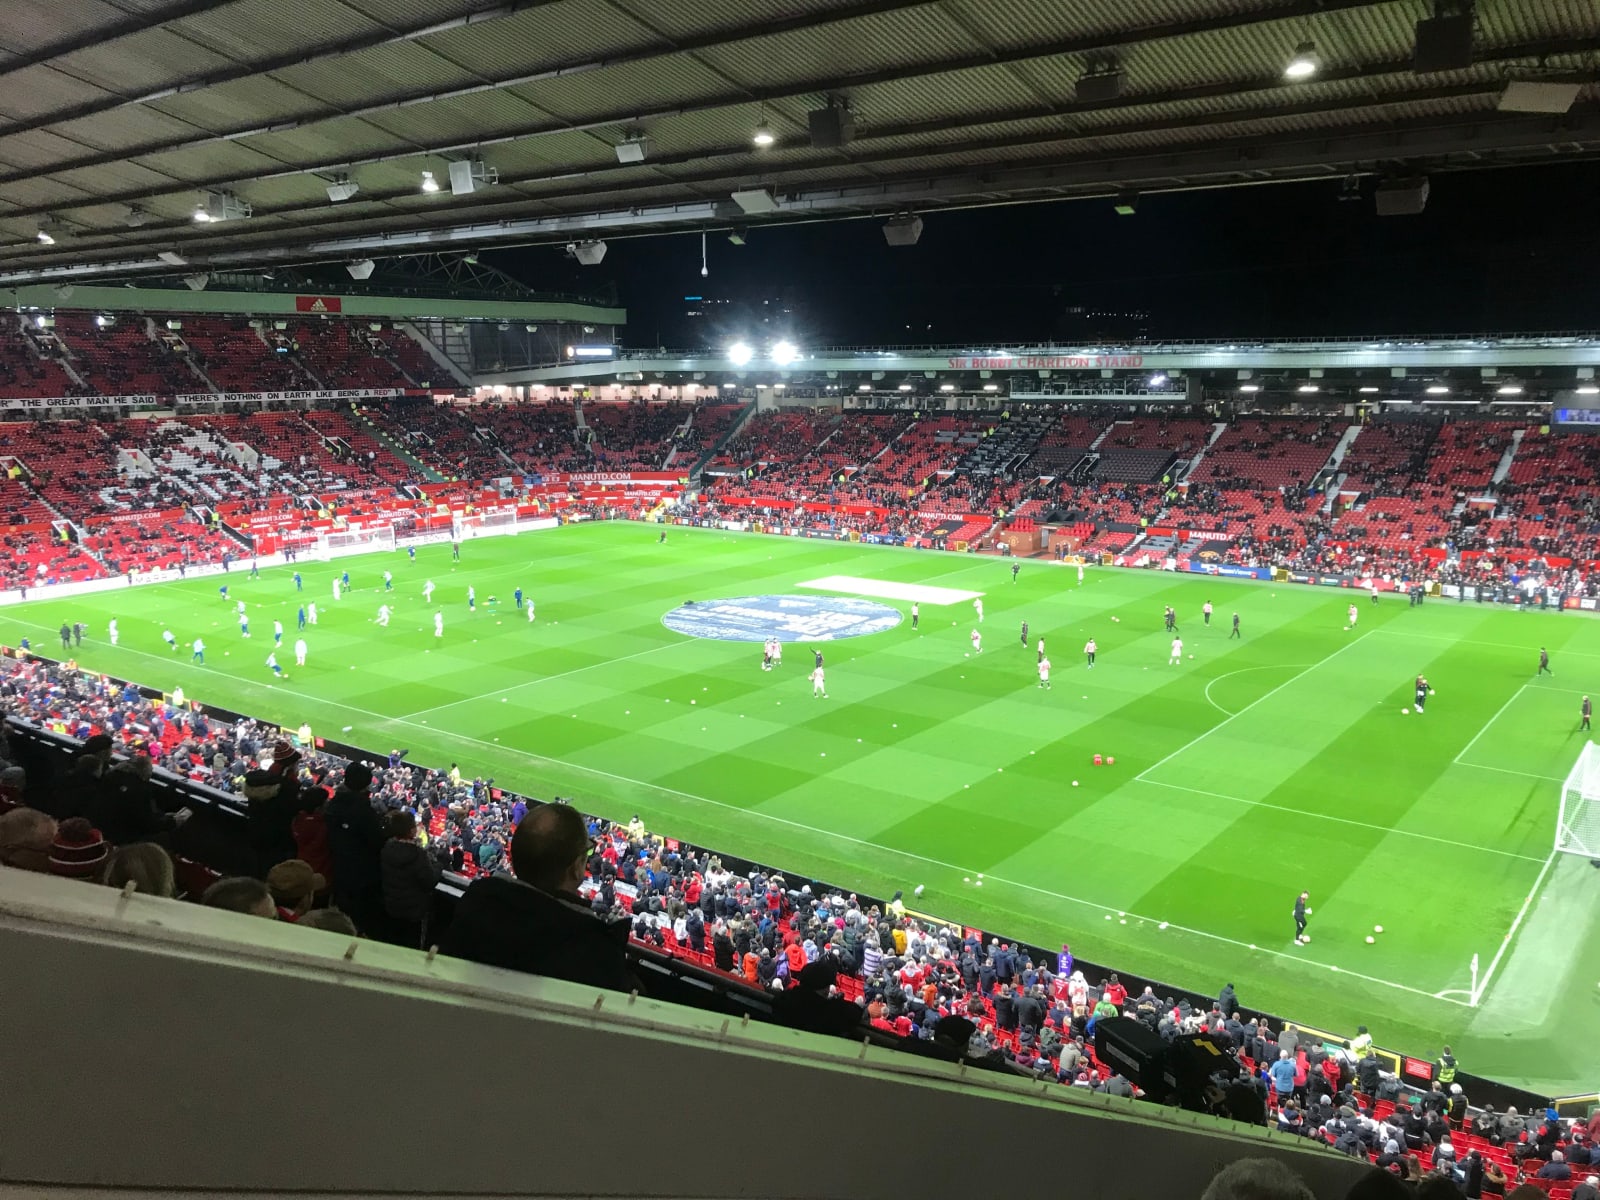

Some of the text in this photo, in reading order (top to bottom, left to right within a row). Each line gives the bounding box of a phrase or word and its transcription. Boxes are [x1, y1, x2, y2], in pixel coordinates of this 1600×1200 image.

[948, 358, 966, 368] SIR
[1018, 357, 1089, 368] CHARLTON
[1095, 356, 1142, 367] STAND
[224, 393, 262, 401] NOTHING
[284, 391, 311, 399] EARTH
[338, 389, 359, 397] BEING
[20, 399, 41, 407] THE
[47, 398, 81, 406] GREAT
[86, 397, 110, 405] MAN
[114, 396, 127, 404] HE
[132, 396, 155, 404] SAID
[569, 472, 631, 481] MANUTD.COM
[918, 511, 963, 521] MANUTD.COM
[1189, 531, 1237, 541] MANUTD.C
